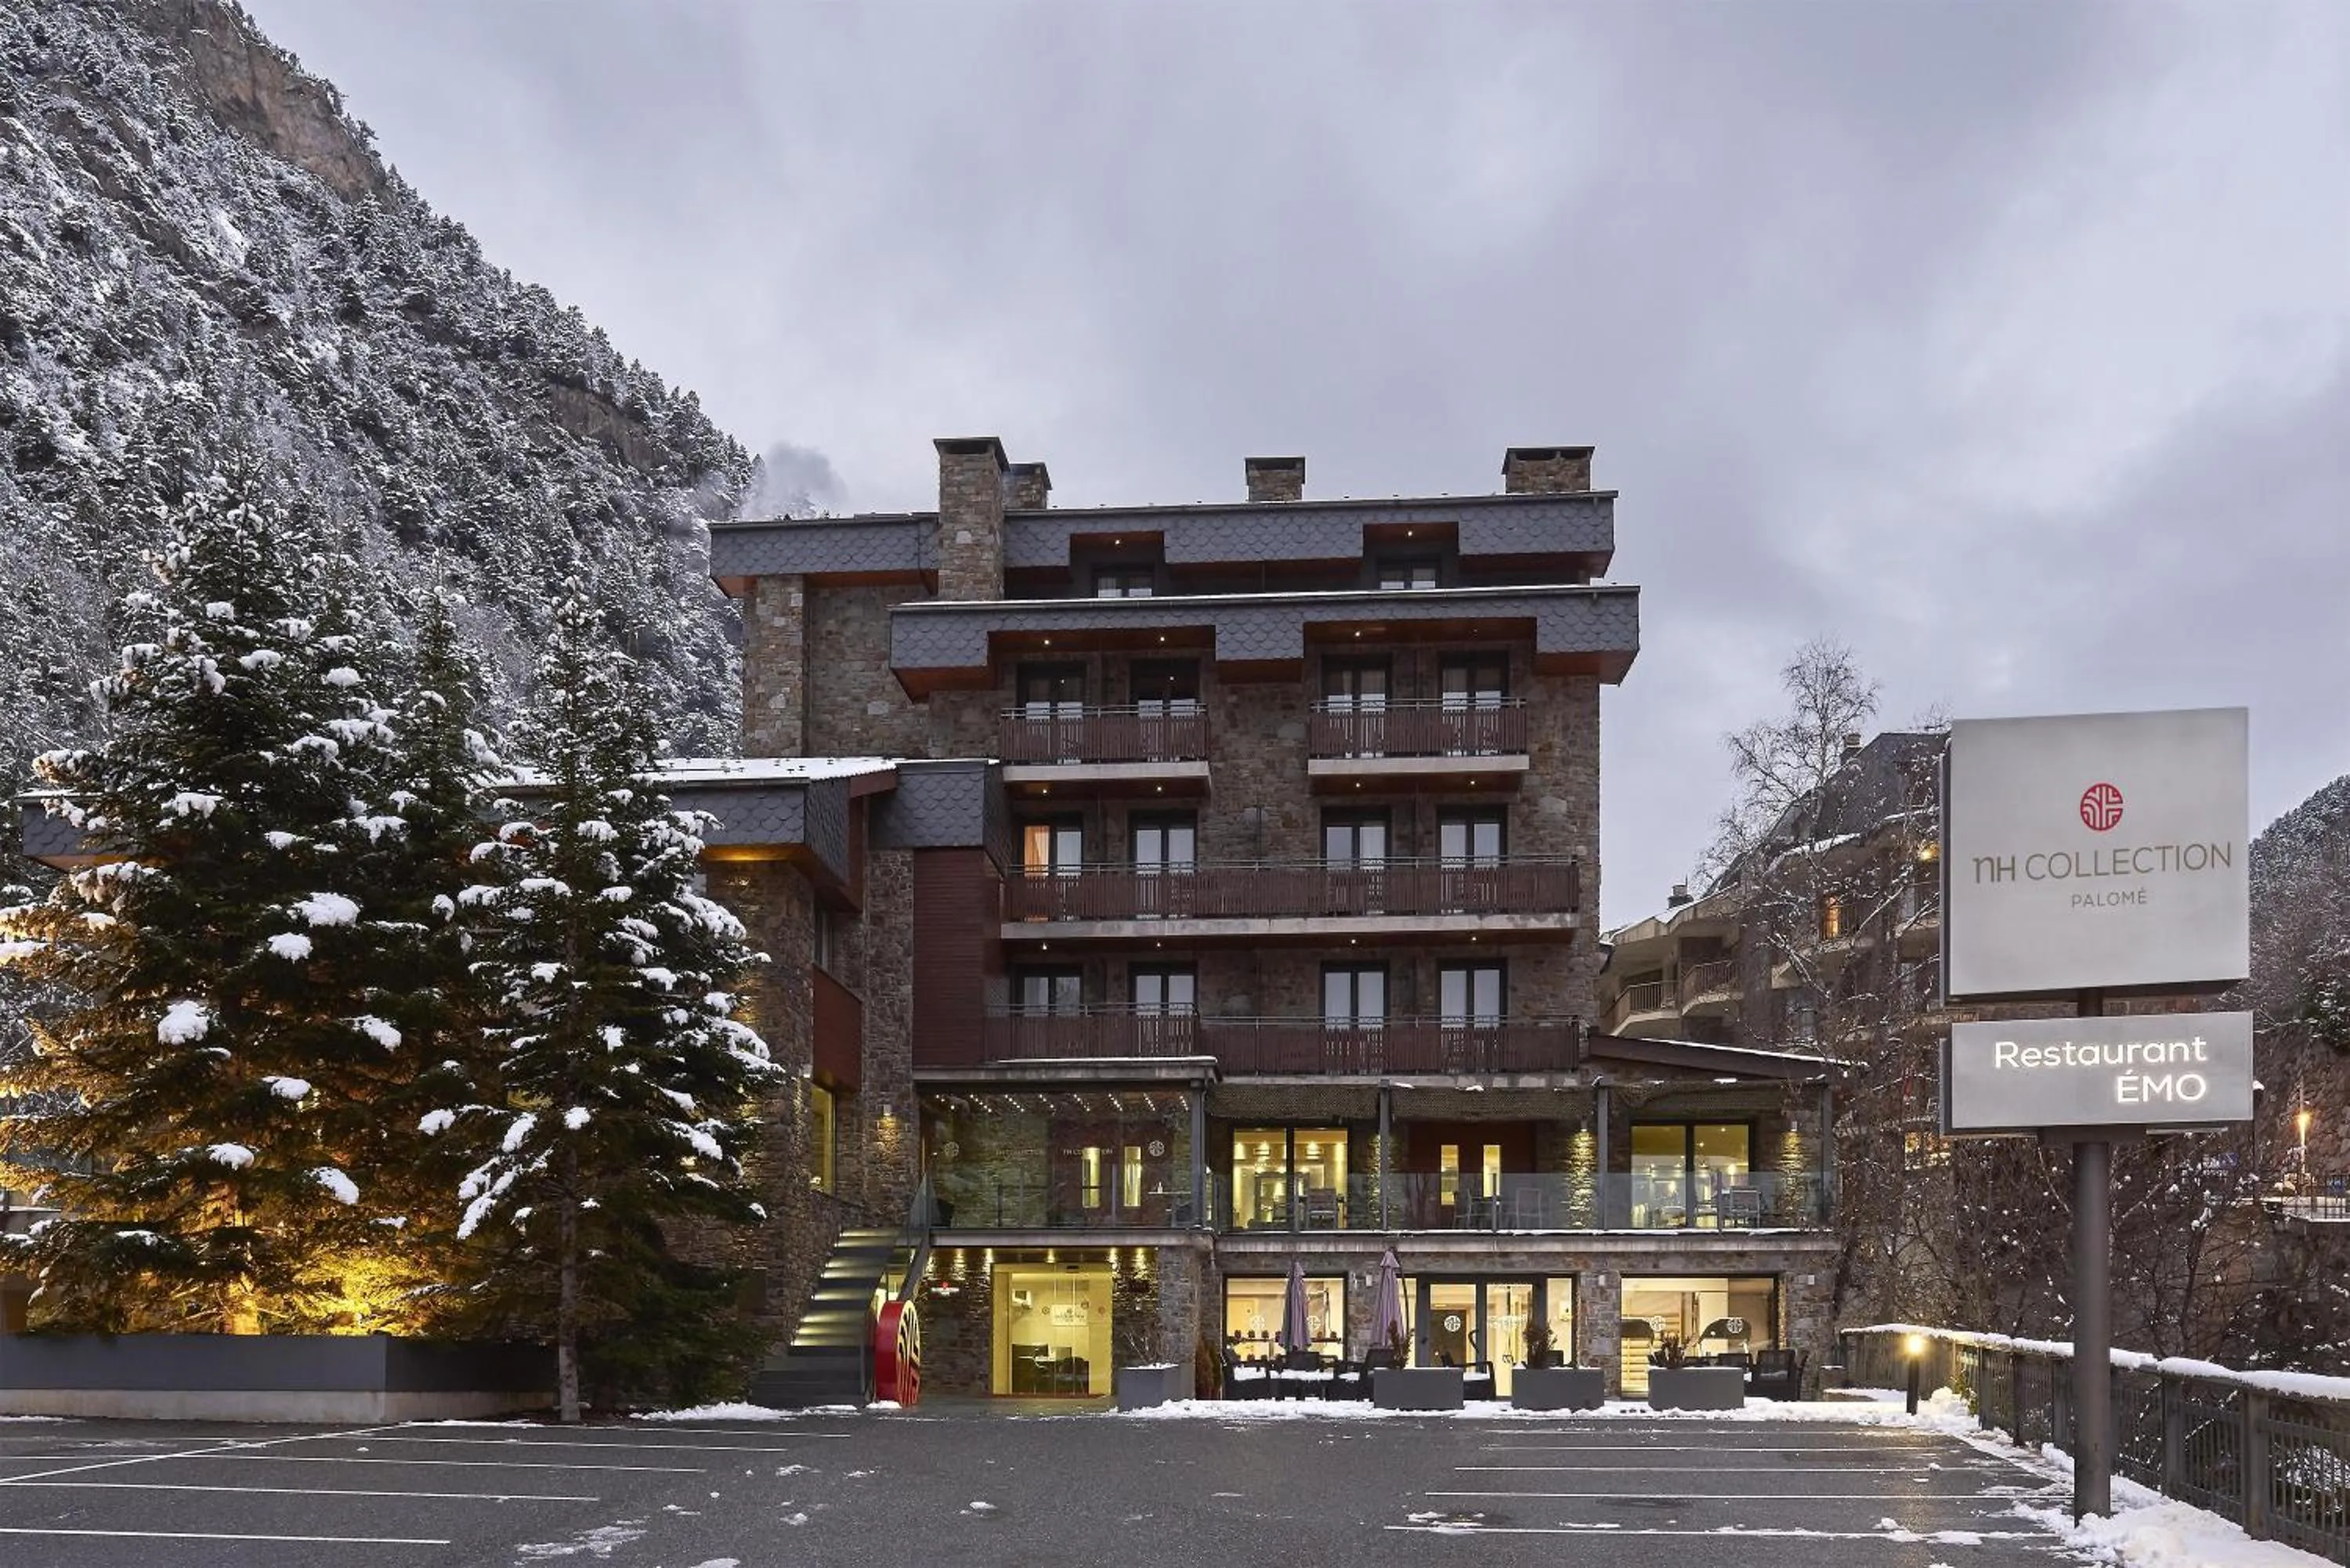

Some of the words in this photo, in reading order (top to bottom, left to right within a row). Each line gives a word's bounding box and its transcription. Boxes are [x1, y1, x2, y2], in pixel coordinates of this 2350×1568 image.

[2025, 842, 2232, 881] COLLECTION
[2071, 887, 2147, 908] PALOMÉ
[1995, 1036, 2207, 1068] Restaurant
[2117, 1069, 2207, 1103] ÉMO
